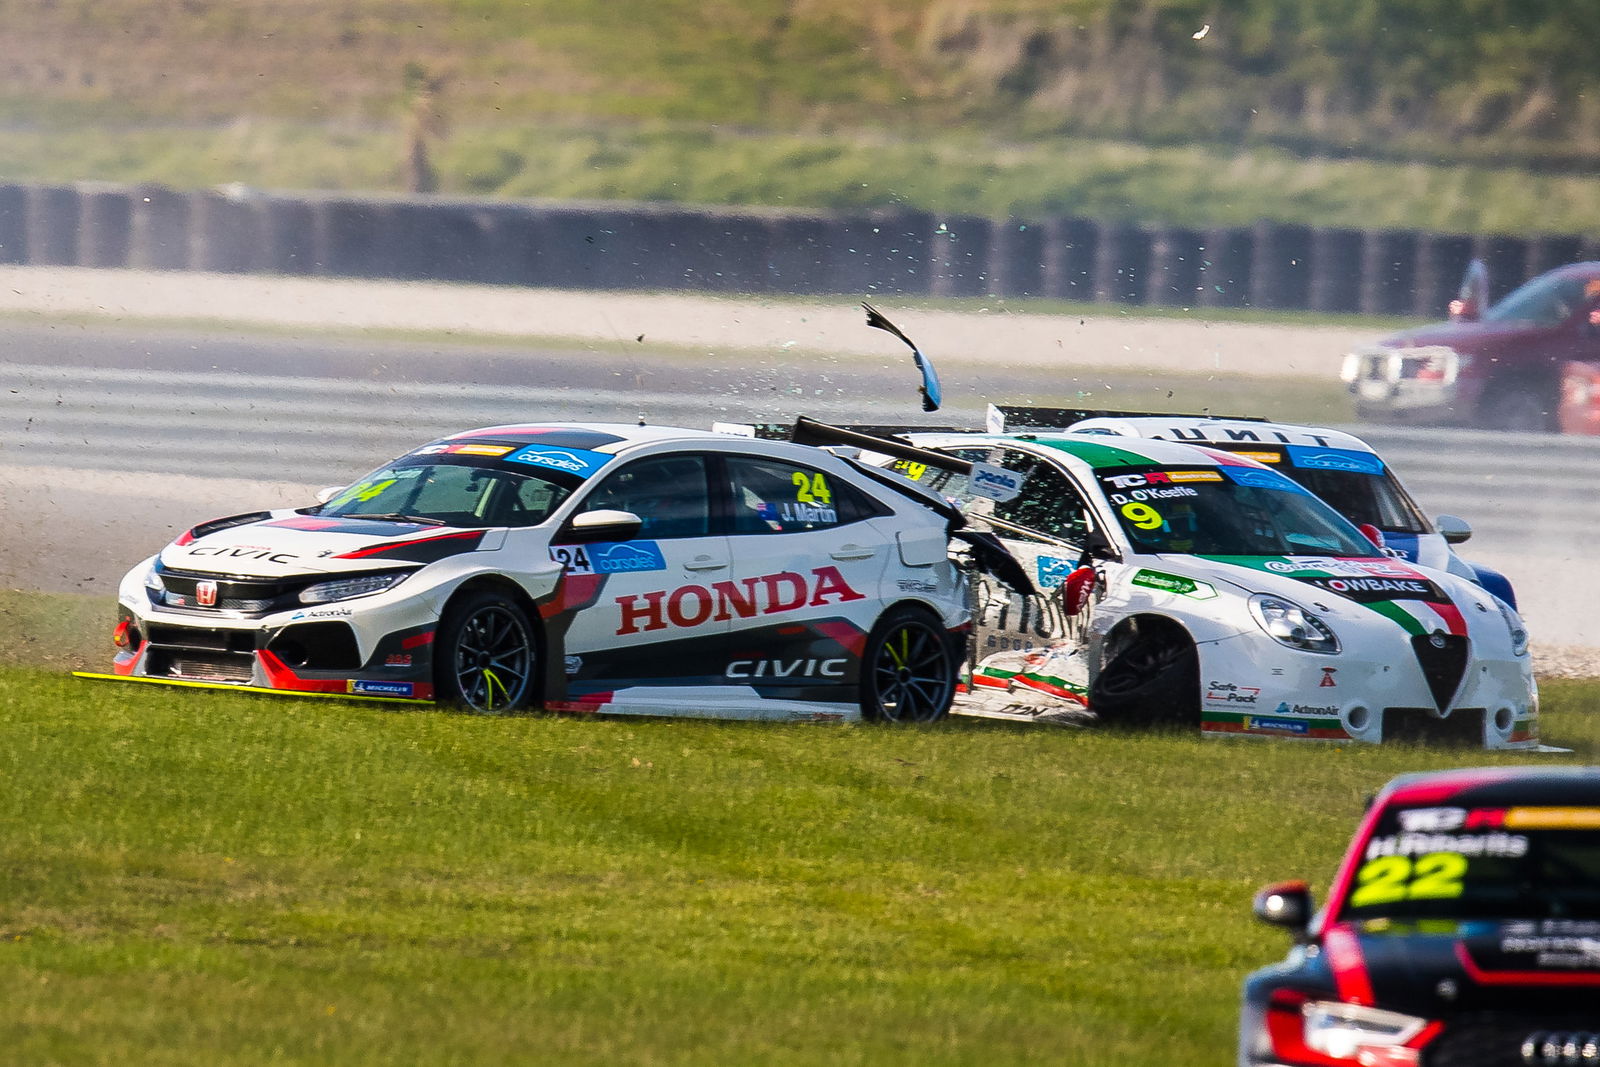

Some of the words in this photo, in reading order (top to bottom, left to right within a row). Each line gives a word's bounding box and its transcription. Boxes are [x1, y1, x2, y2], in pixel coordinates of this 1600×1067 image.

[517, 452, 584, 471] carsales
[791, 471, 832, 504] 24
[1103, 472, 1171, 489] TCR
[1110, 492, 1134, 505] D.
[1130, 486, 1199, 501] O'Keeffe
[781, 503, 794, 522] J.
[793, 503, 838, 523] Martin
[1120, 501, 1163, 530] 9
[188, 547, 299, 564] CIVIC
[557, 547, 590, 572] 24
[599, 555, 656, 571] carsales
[1315, 576, 1428, 593] OWBAKE
[615, 565, 867, 636] HONDA
[725, 658, 848, 679] CIVIC
[1208, 680, 1238, 692] Safe
[1226, 692, 1257, 704] Pack
[1292, 704, 1340, 716] ActronAir
[1350, 852, 1469, 907] 22
